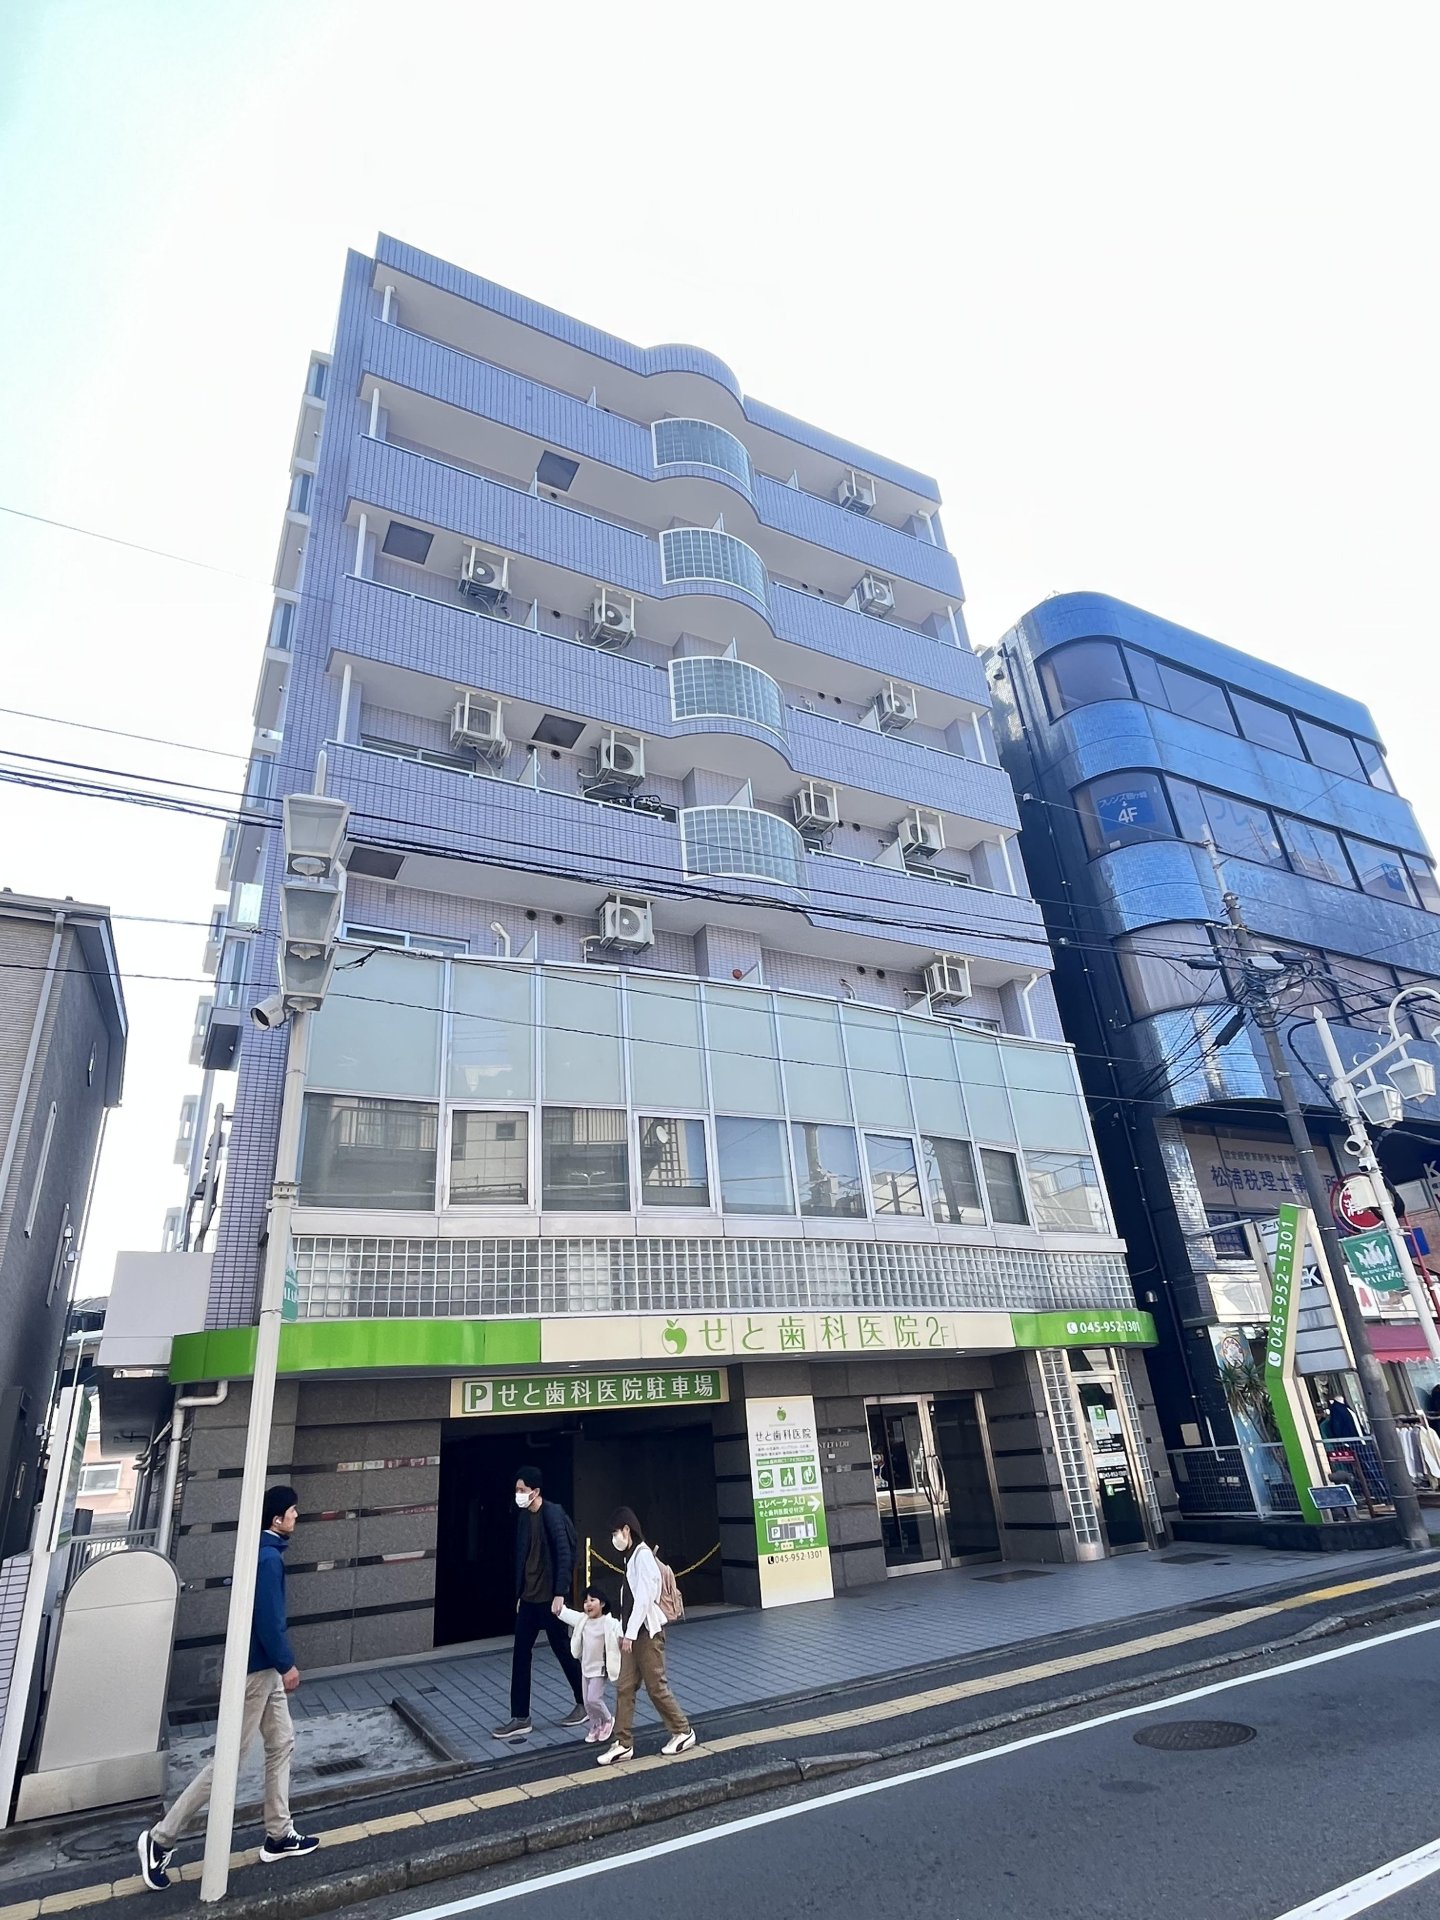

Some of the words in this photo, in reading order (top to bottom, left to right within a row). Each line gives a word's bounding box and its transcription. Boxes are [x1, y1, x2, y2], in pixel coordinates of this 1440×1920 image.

[1118, 806, 1138, 823] 4F
[1211, 1164, 1336, 1193] 松浦税理士事所
[1269, 1221, 1294, 1348] 045-952-1301
[1079, 1320, 1141, 1333] 045-952-1301
[470, 1384, 488, 1410] P
[498, 1374, 714, 1407] せと歯科医院駐車場
[755, 1427, 812, 1442] せと歯科医院
[758, 1495, 806, 1509] エレベーター入口
[774, 1550, 823, 1564] 045-952-1301
